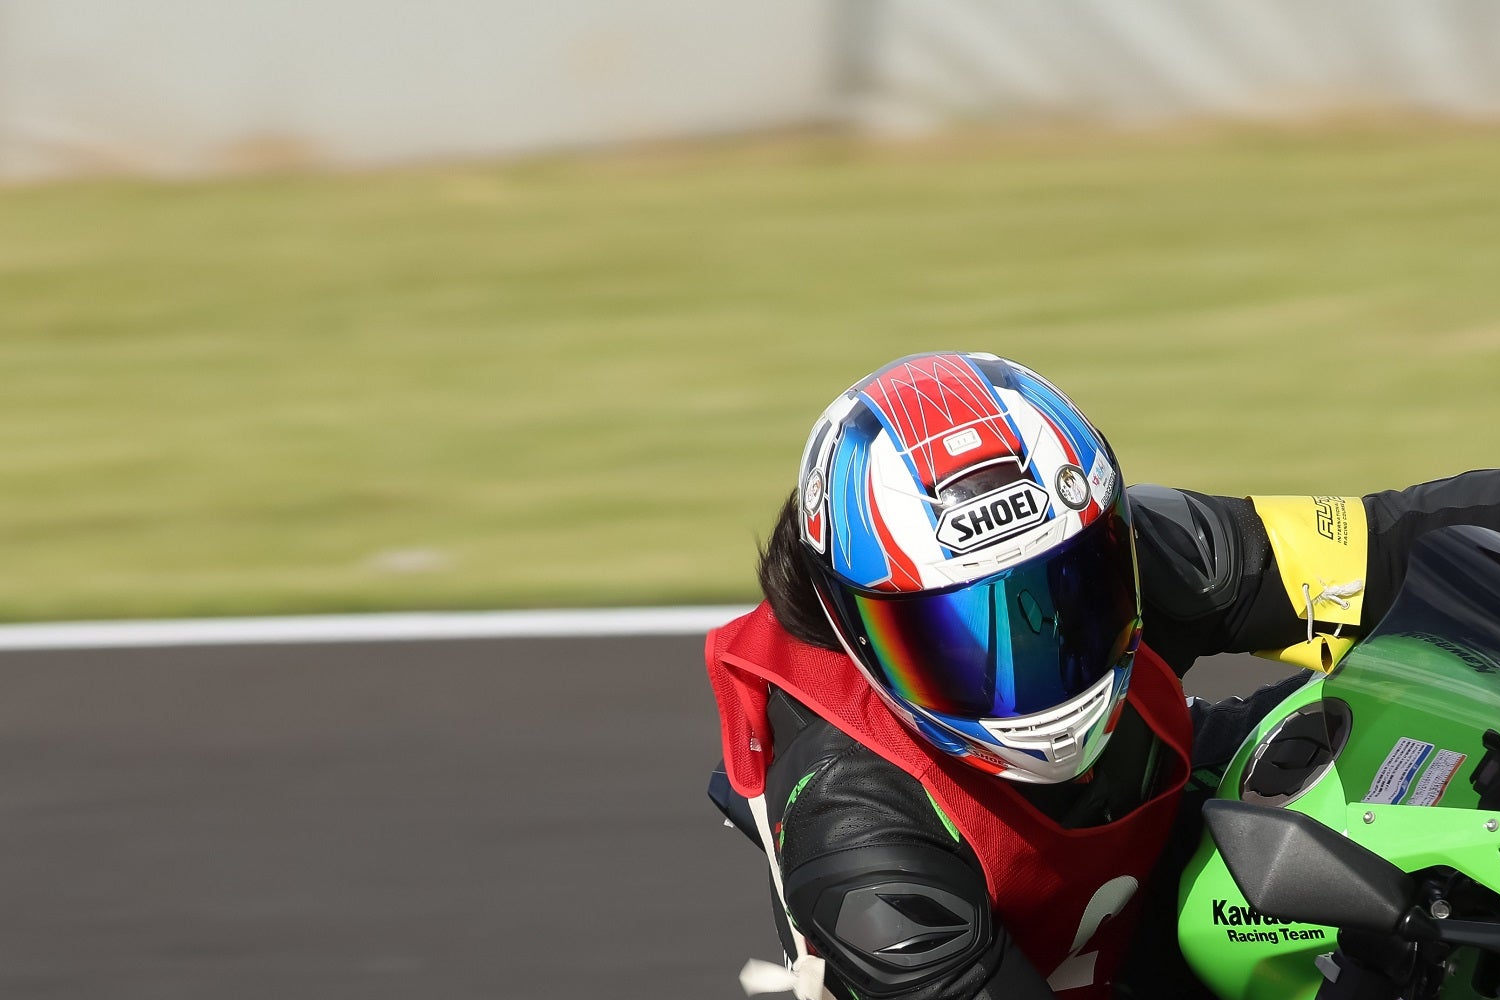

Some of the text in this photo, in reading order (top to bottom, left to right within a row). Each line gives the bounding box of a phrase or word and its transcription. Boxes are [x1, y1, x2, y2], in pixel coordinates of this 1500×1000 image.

[950, 489, 1039, 543] SHOEI
[1226, 927, 1326, 945] Racing Team
